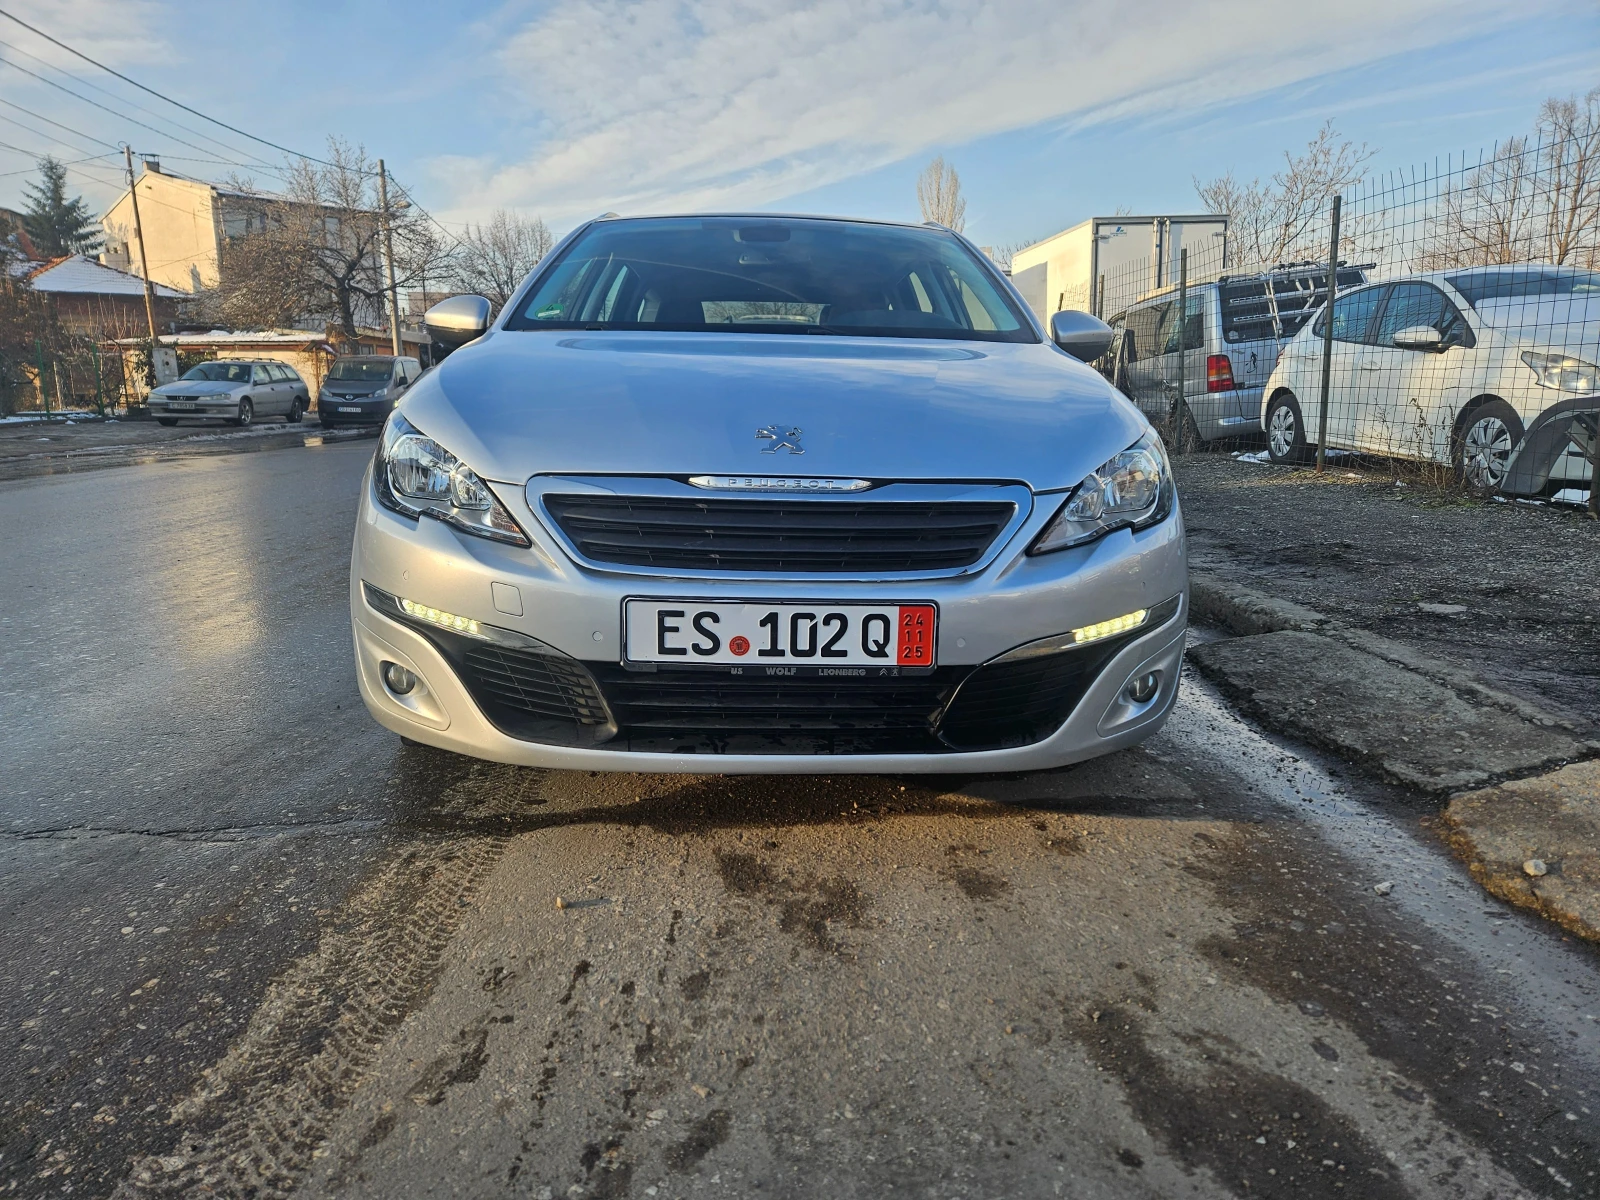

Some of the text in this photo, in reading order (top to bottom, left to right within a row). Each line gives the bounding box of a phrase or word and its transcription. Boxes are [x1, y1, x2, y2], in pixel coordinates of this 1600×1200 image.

[728, 478, 834, 489] PEUGEOT
[903, 613, 923, 627] 24
[657, 610, 721, 656] ES
[757, 611, 848, 658] 102
[861, 613, 891, 658] Q
[904, 629, 922, 643] 11
[903, 645, 923, 658] 25
[766, 667, 797, 676] WOLF
[818, 668, 866, 676] LEONBERG
